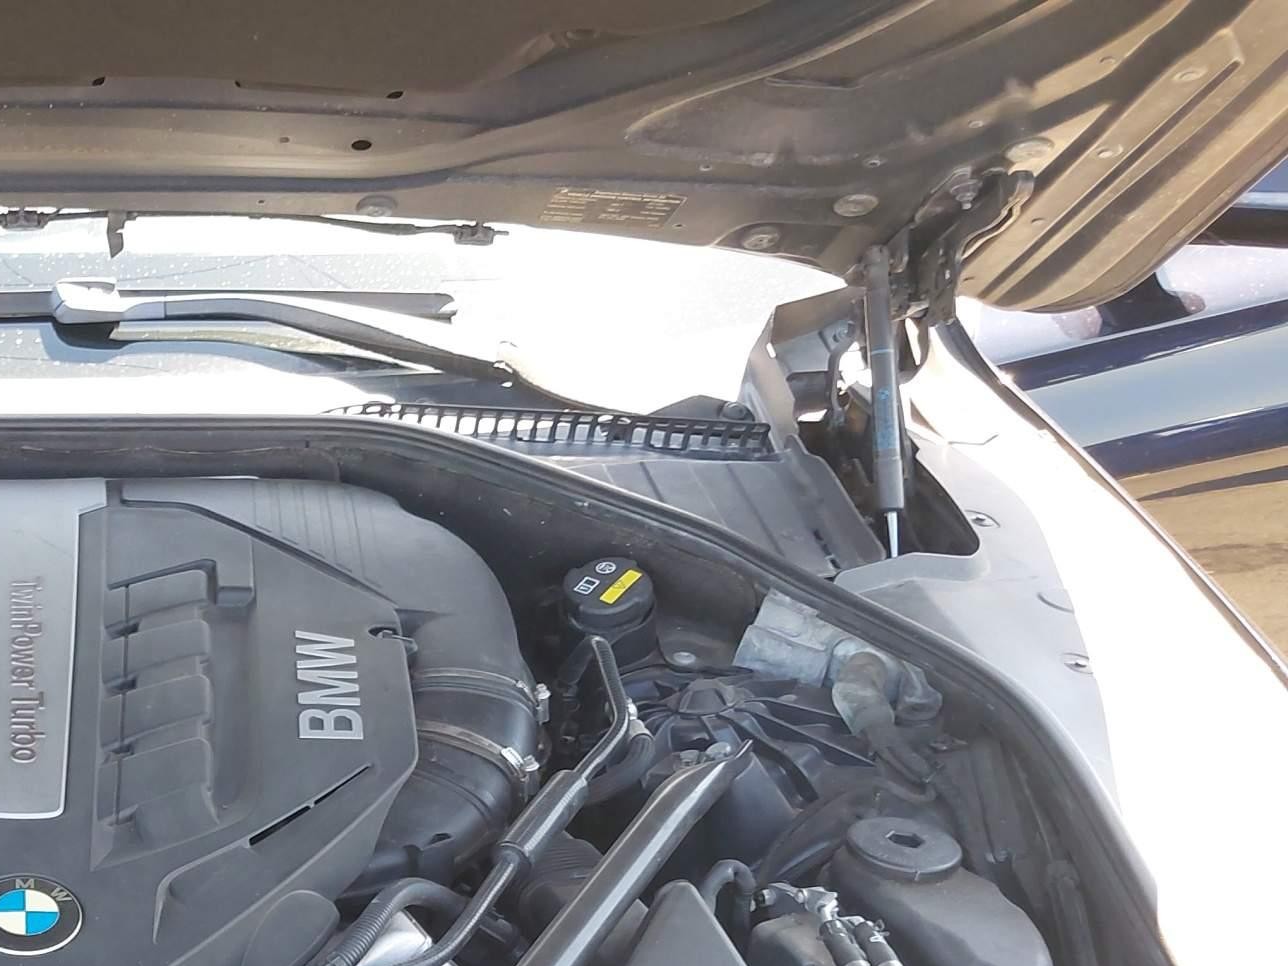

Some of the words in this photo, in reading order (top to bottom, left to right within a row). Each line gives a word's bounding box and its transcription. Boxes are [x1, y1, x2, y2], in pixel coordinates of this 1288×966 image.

[10, 576, 44, 690] TwinPower
[295, 630, 364, 740] BMW
[10, 691, 48, 763] Turbo
